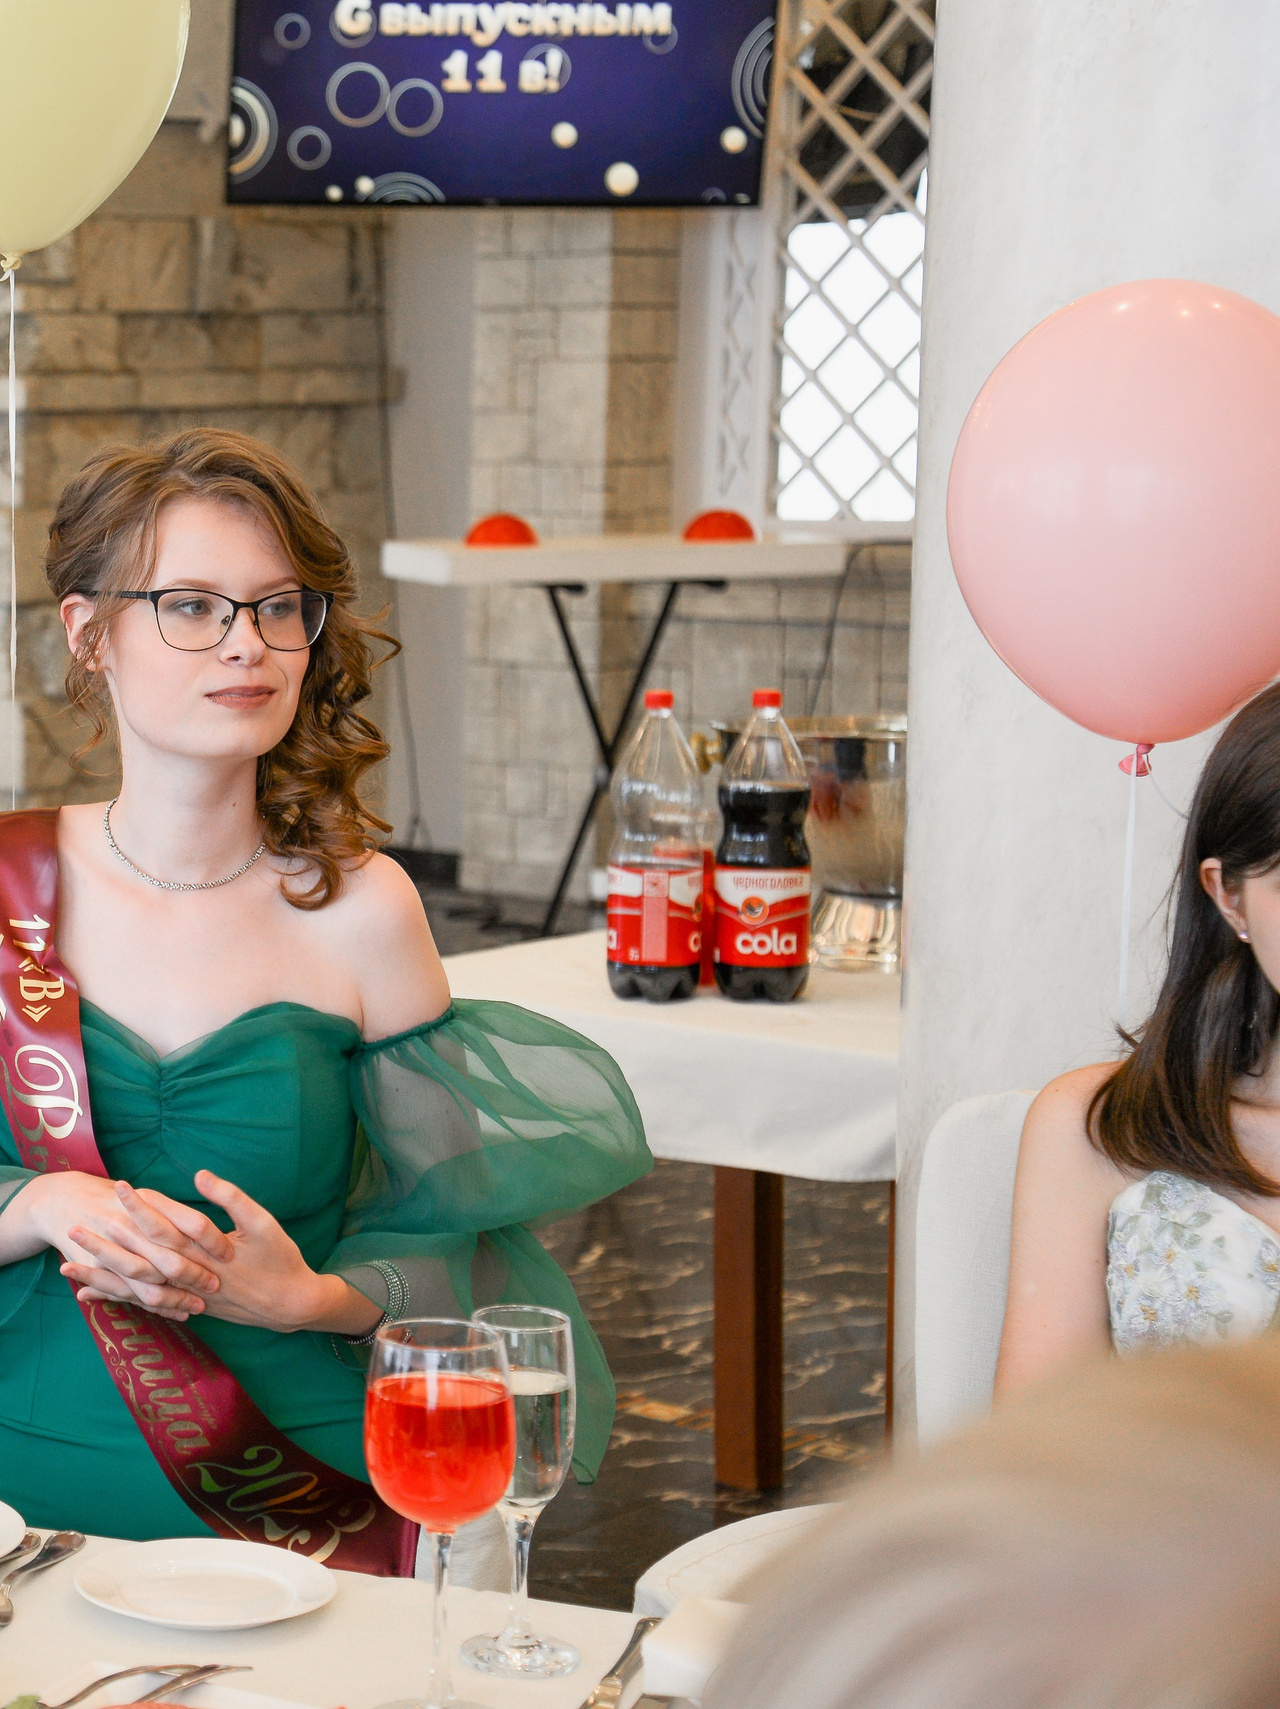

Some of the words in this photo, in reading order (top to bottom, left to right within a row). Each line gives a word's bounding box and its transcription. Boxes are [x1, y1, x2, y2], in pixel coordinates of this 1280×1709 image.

[378, 2, 674, 48] выпускным
[441, 49, 507, 94] 11
[736, 927, 798, 956] cola
[185, 1445, 378, 1563] 2023
